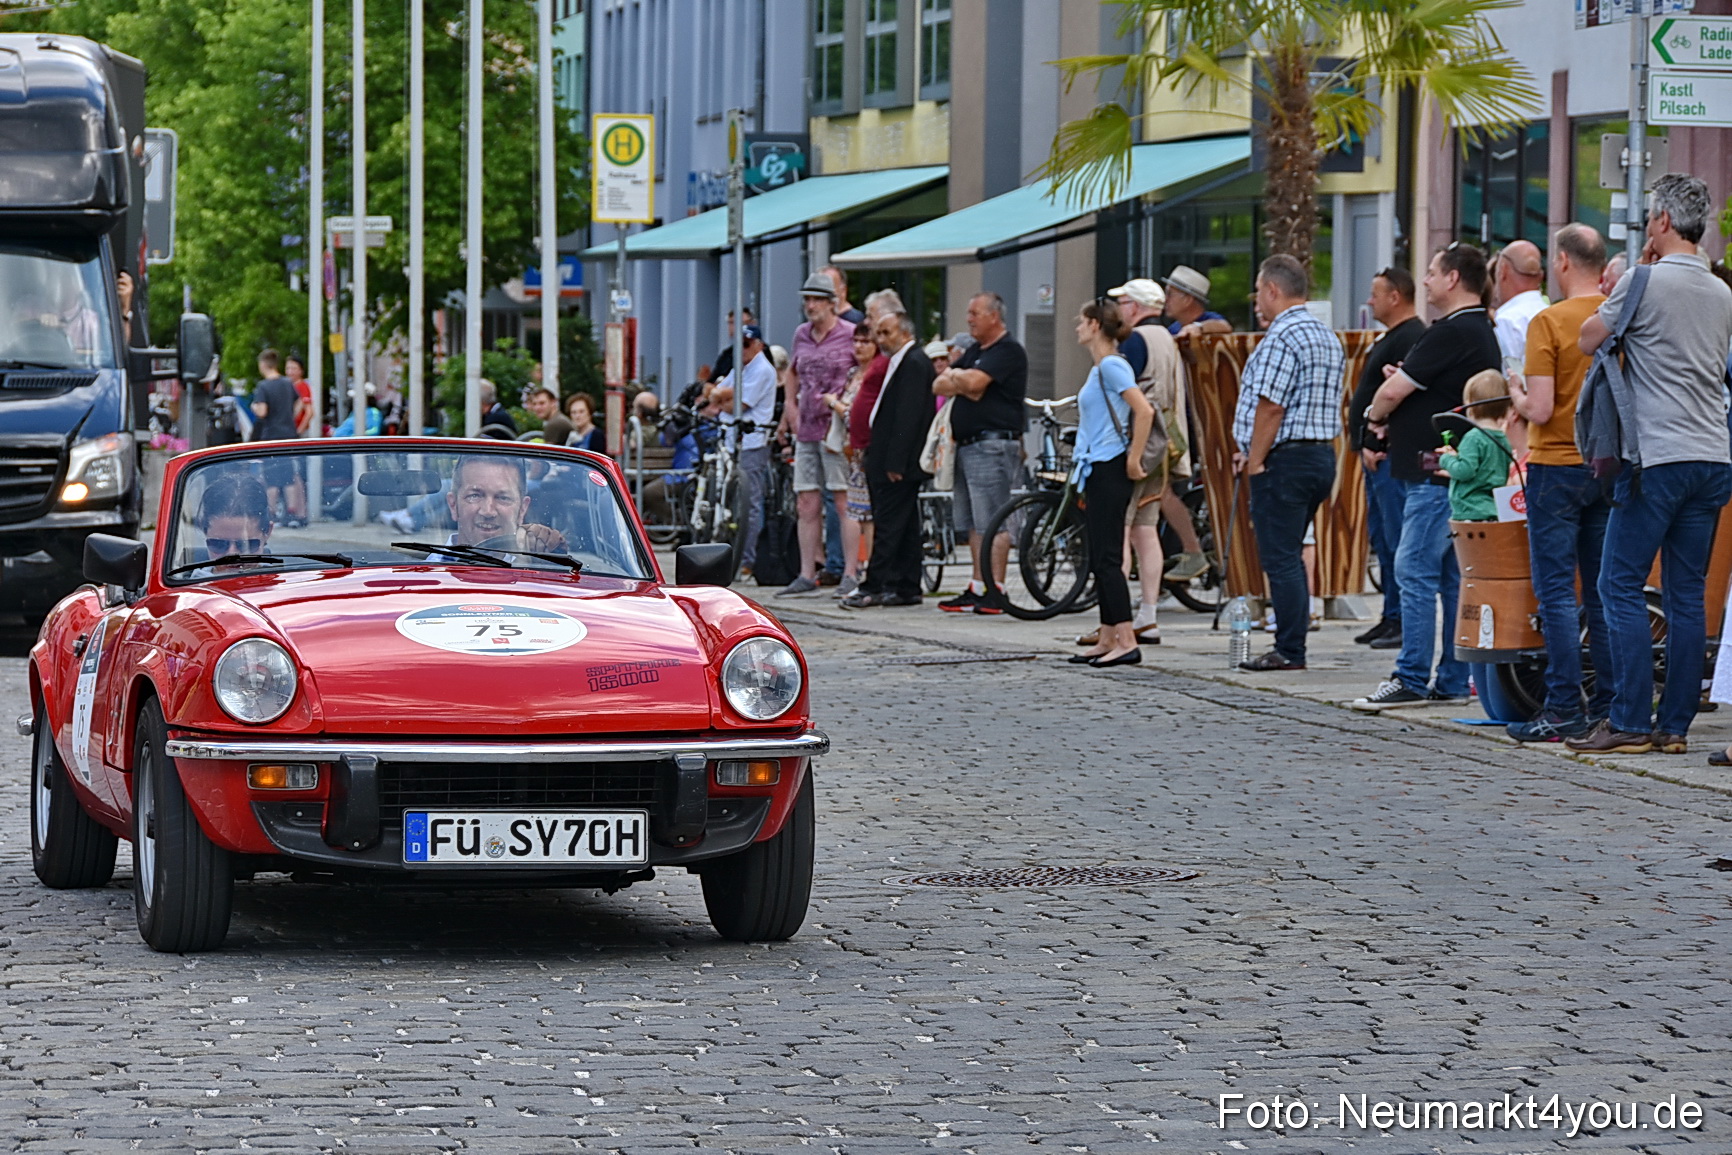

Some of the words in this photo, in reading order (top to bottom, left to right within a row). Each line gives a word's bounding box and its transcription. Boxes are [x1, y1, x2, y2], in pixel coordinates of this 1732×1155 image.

[1660, 81, 1693, 97] Kastl
[1659, 100, 1706, 116] Pilsach
[466, 624, 523, 637] 75
[586, 659, 682, 677] SPITFIRE
[588, 669, 660, 692] 1500
[430, 818, 481, 856] FÜ
[411, 842, 421, 854] D
